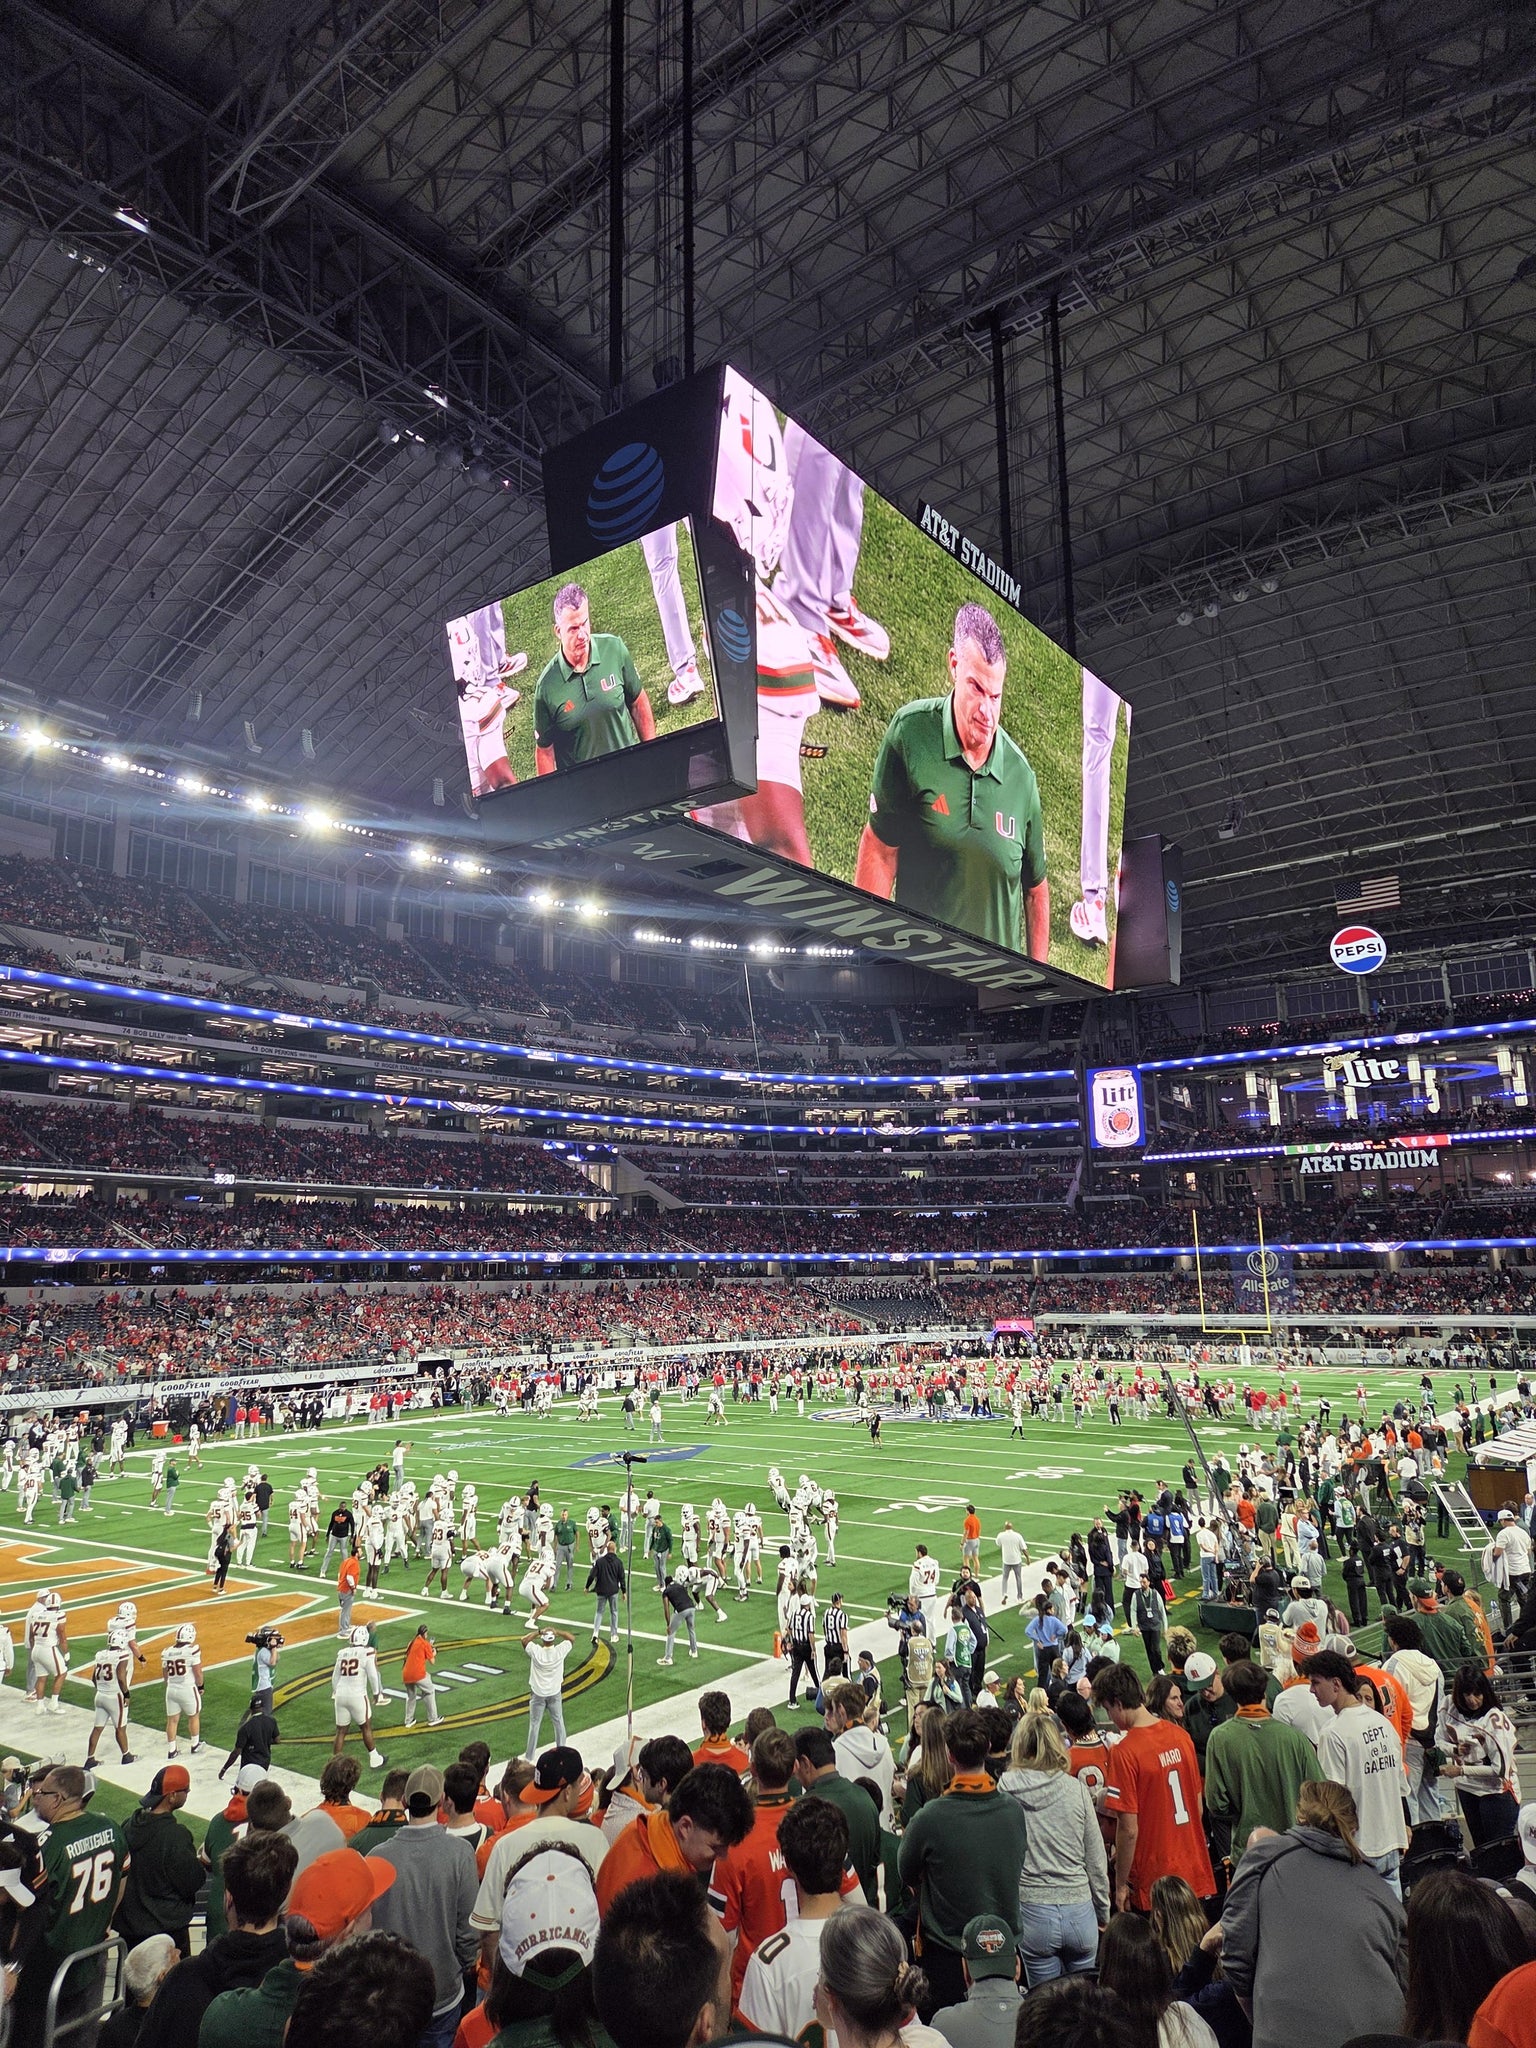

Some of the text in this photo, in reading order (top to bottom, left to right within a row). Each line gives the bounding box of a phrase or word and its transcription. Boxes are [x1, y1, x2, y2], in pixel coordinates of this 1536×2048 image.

[920, 504, 1021, 608] AT&T STADIUM
[532, 800, 706, 850] WINSTAR
[995, 811, 1016, 839] U
[714, 868, 1046, 989] WINSTAR
[1335, 943, 1382, 957] PEPSI
[133, 1029, 148, 1037] BOB
[260, 1047, 273, 1055] DON
[274, 1049, 298, 1057] PERKINS
[399, 1064, 424, 1073] STAUBACH
[1343, 1058, 1400, 1088] Lite
[1102, 1086, 1135, 1107] Lite
[1300, 1149, 1440, 1174] AT&T STADIUM
[1241, 1278, 1290, 1293] Allsate
[373, 1366, 406, 1374] GOODYEAR
[160, 1381, 211, 1391] GOODYEAR
[220, 1378, 260, 1387] GOODYEAR
[1239, 1460, 1250, 1469] 10
[775, 1479, 782, 1487] 7
[529, 1559, 545, 1574] 61
[924, 1570, 936, 1585] 74
[33, 1622, 50, 1637] 27
[795, 1615, 803, 1630] R
[828, 1616, 835, 1630] B
[166, 1659, 187, 1677] 66
[340, 1658, 359, 1676] 62
[1489, 1712, 1510, 1731] 26
[1379, 1742, 1388, 1753] la
[1158, 1748, 1182, 1768] WARD
[1168, 1769, 1190, 1826] 1
[65, 1828, 116, 1859] RODRIGUEZ
[768, 1848, 787, 1873] WA
[69, 1849, 116, 1915] 76
[515, 1925, 592, 1961] HURRICANES
